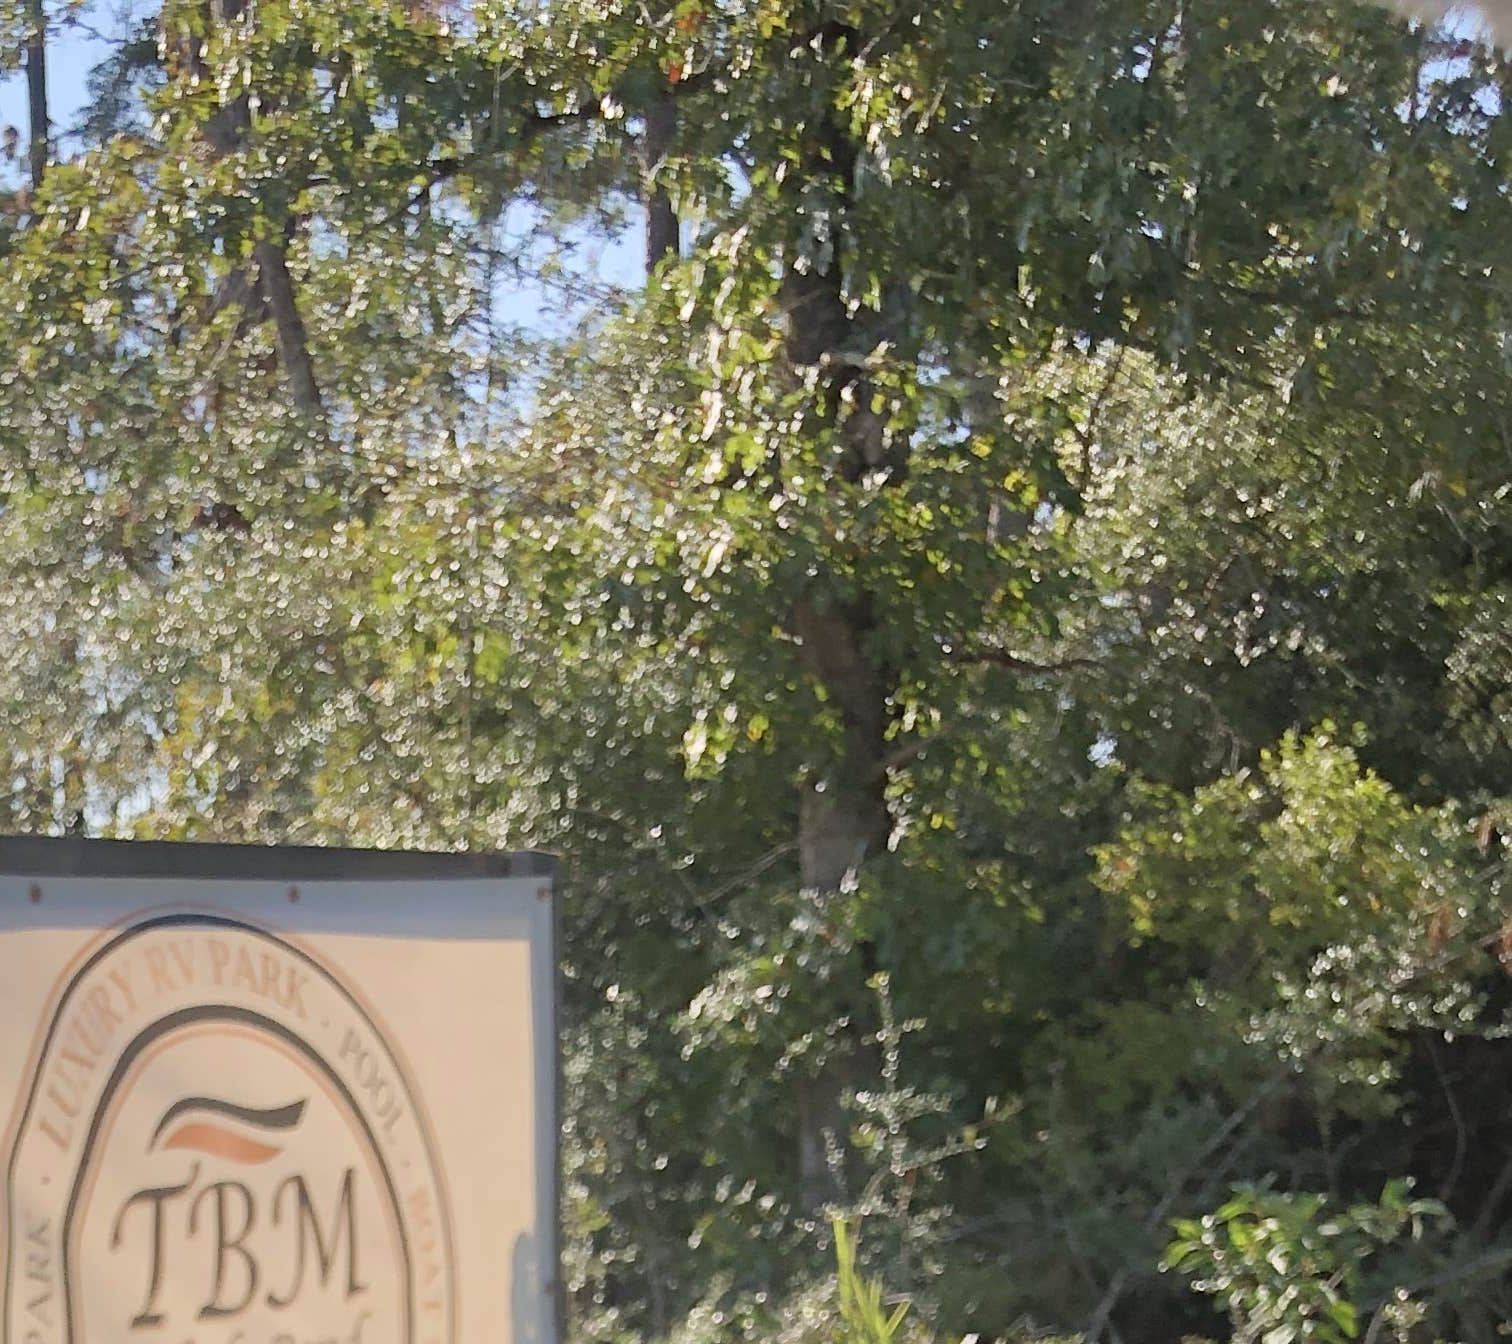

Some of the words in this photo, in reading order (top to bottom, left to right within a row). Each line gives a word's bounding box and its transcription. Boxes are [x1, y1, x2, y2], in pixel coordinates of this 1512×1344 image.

[38, 958, 138, 1152] LUXURY
[143, 938, 195, 997] RV
[205, 938, 310, 1021] PARK
[338, 1026, 405, 1146] POOL
[109, 1160, 369, 1330] TBM
